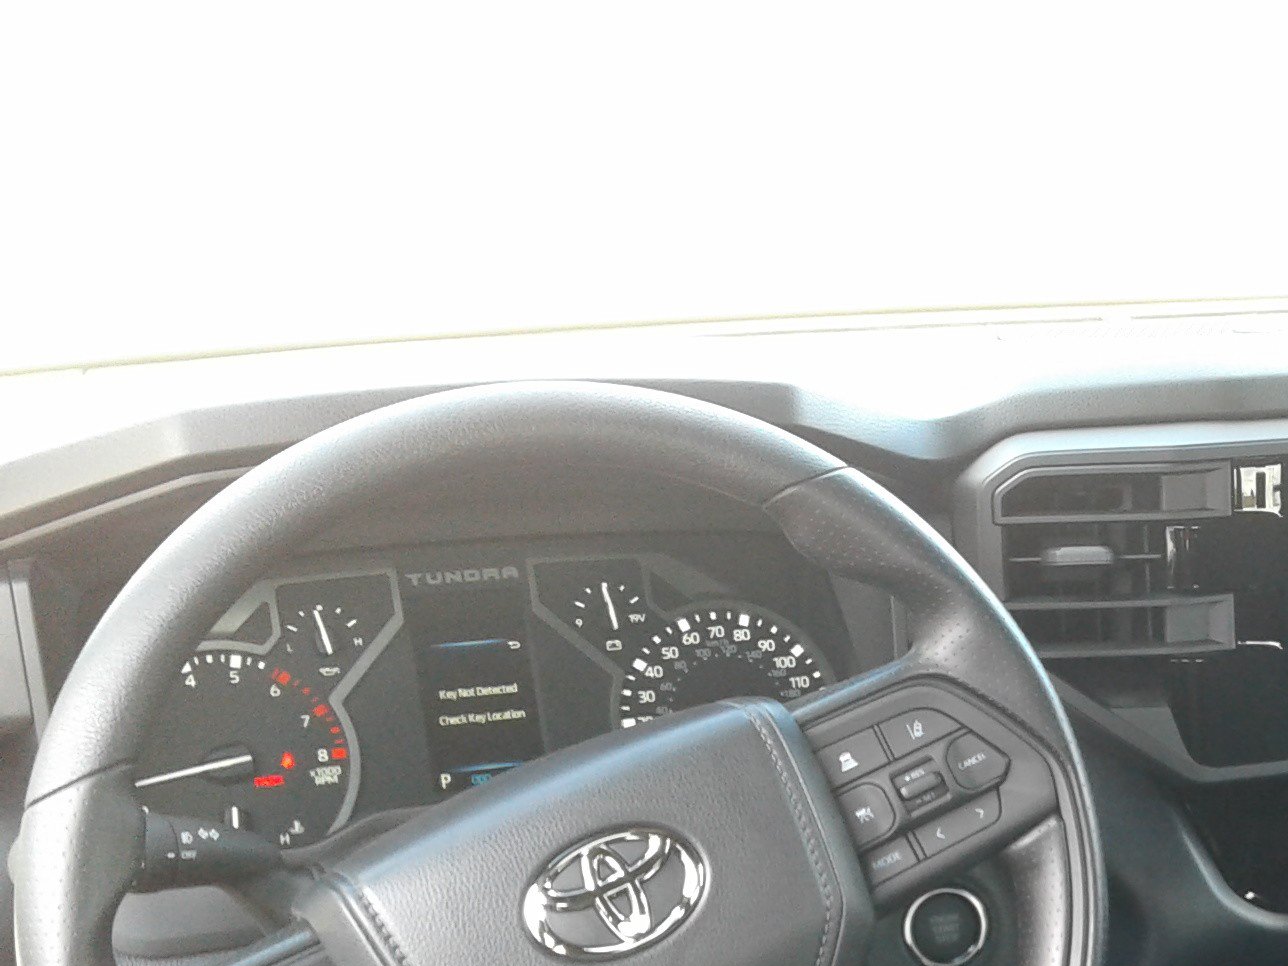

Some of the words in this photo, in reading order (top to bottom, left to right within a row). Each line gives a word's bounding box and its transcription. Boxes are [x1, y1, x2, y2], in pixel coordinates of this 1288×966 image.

[404, 566, 519, 586] TUNDRA
[682, 632, 700, 646] 60
[707, 625, 725, 639] 70
[732, 628, 751, 642] 80
[661, 646, 679, 660] 50
[757, 639, 776, 653] 90
[772, 656, 796, 669] 100
[229, 671, 240, 684] 5
[645, 665, 664, 678] 40
[184, 674, 196, 688] 4
[789, 675, 810, 689] 110
[269, 683, 281, 697] 6
[438, 689, 457, 701] Key
[476, 682, 518, 697] Detected
[637, 690, 656, 704] 30
[300, 714, 311, 728] 7
[439, 714, 468, 726] Check
[468, 713, 487, 724] Key
[487, 709, 526, 722] Location
[317, 748, 328, 763] 8
[440, 773, 451, 789] P
